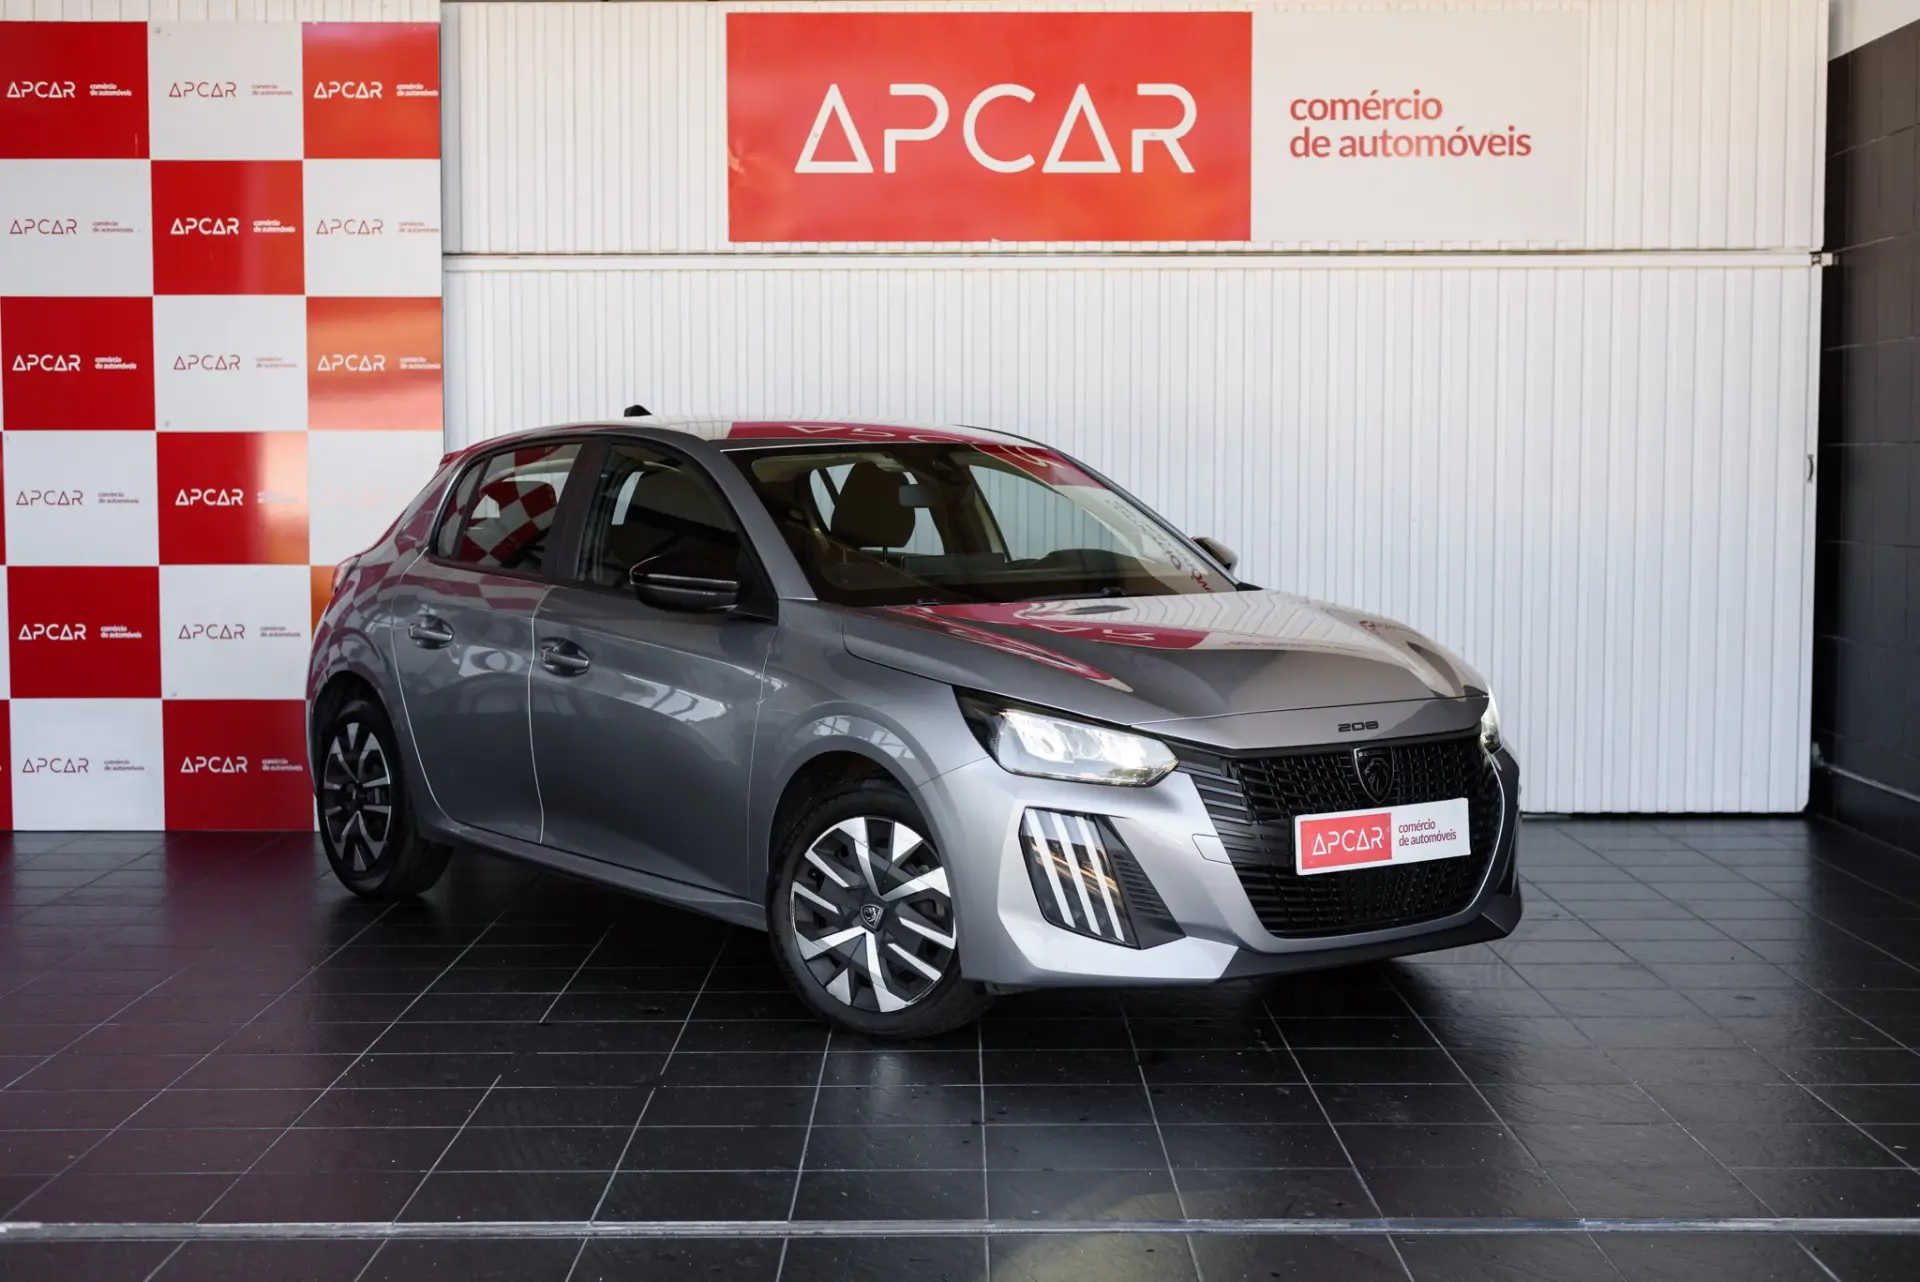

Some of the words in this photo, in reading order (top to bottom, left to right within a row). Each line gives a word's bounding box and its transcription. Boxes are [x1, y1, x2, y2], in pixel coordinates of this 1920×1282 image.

[6, 81, 76, 98] APCAR
[168, 82, 237, 98] APCAR
[313, 81, 383, 98] APCAR
[1289, 88, 1443, 121] comércio
[794, 83, 1197, 174] APCAR
[1289, 126, 1331, 158] de
[1338, 125, 1532, 158] automóveis
[9, 219, 78, 235] APCAR
[170, 218, 240, 235] APCAR
[316, 219, 384, 235] APCAR
[12, 354, 81, 371] APCAR
[173, 355, 241, 371] APCAR
[316, 354, 386, 371] APCAR
[16, 490, 84, 506] APCAR
[175, 489, 244, 506] APCAR
[18, 624, 87, 640] APCAR
[178, 624, 246, 640] APCAR
[1337, 720, 1379, 733] 208
[22, 758, 90, 774] APCAR
[180, 756, 248, 773] APCAR
[1398, 818, 1436, 834] comércio
[1312, 826, 1384, 856] APCAR
[1398, 835, 1410, 847] de
[1410, 829, 1457, 845] automóveis
